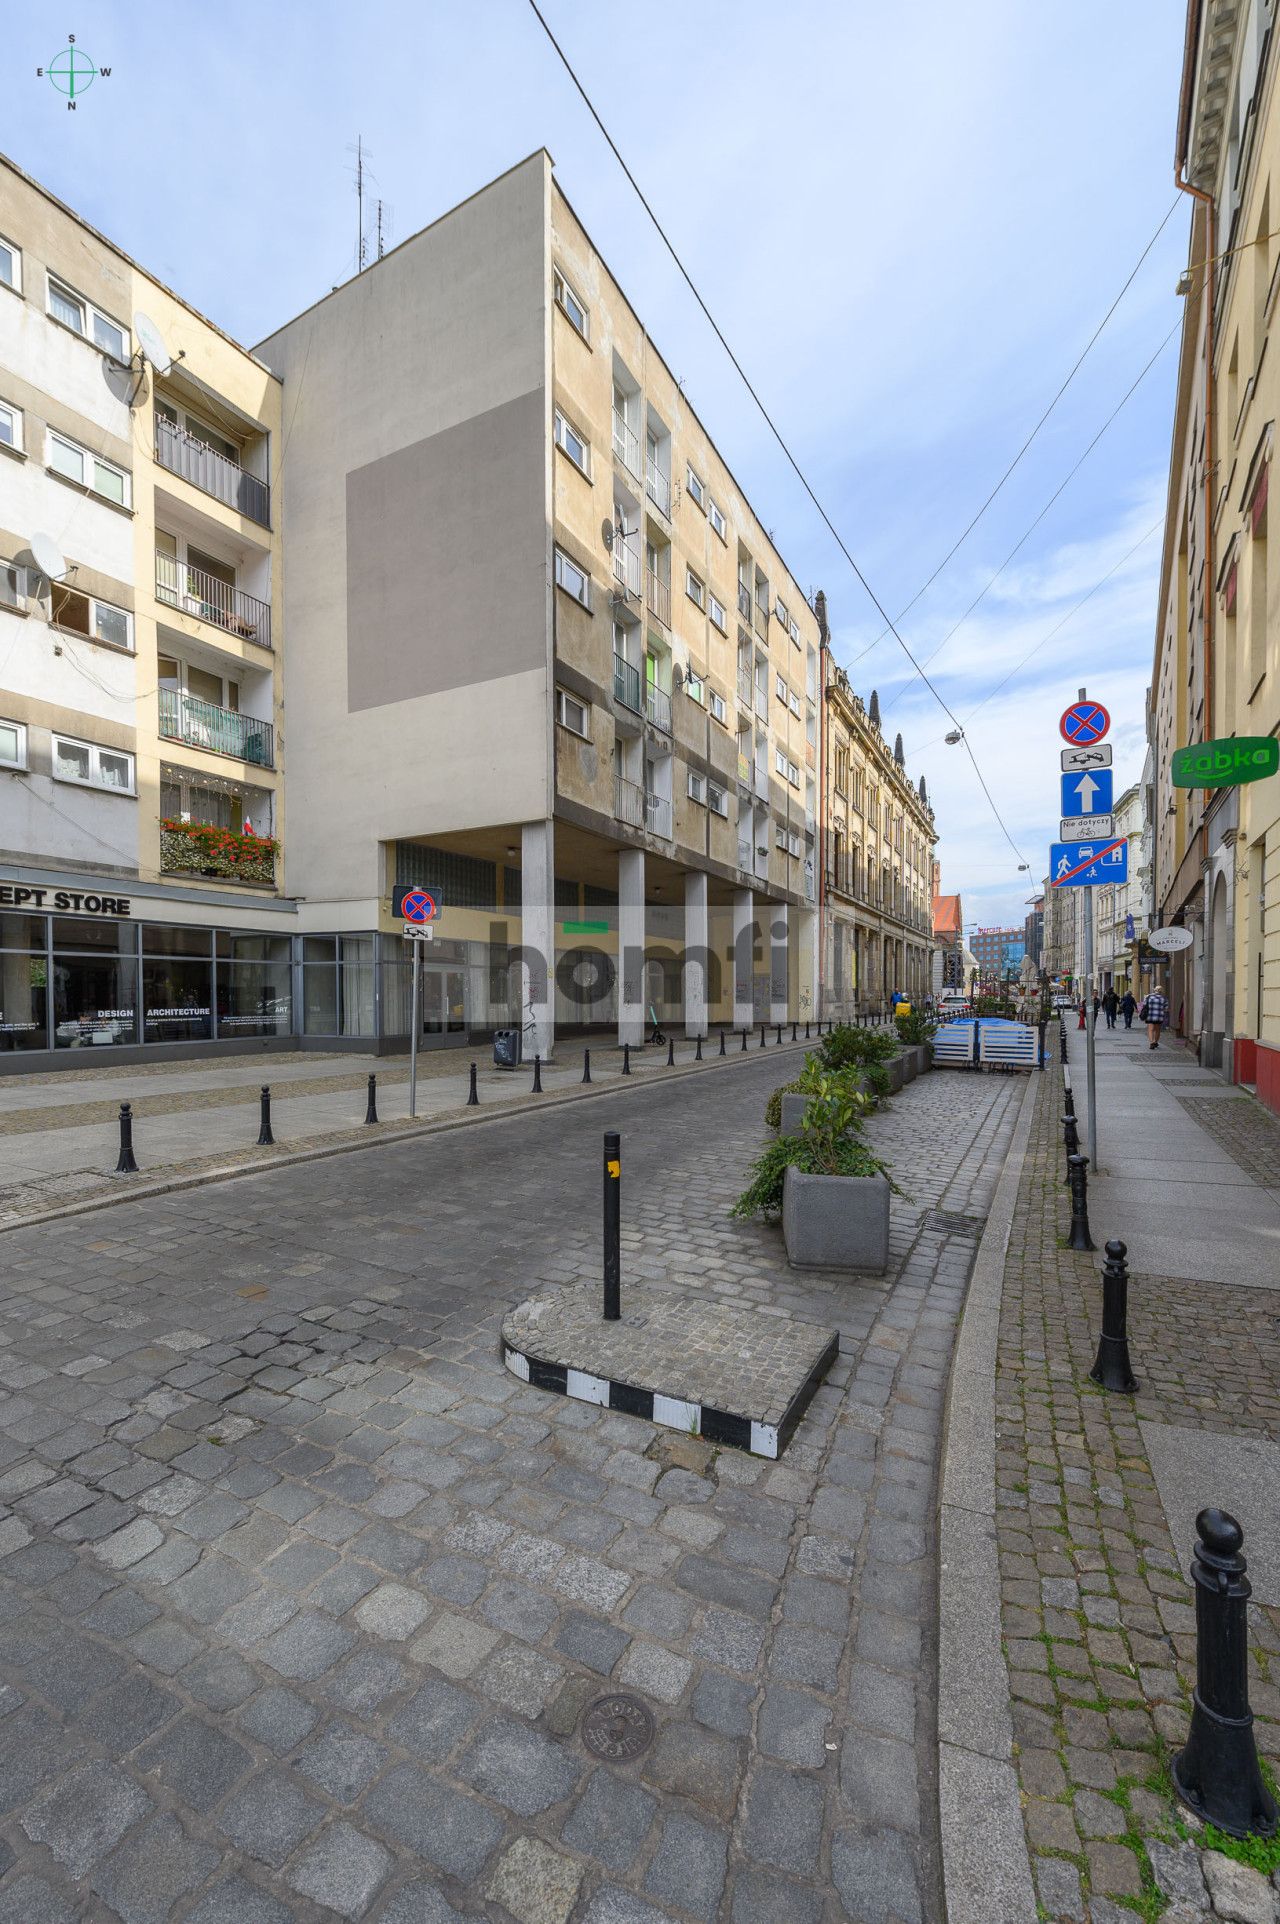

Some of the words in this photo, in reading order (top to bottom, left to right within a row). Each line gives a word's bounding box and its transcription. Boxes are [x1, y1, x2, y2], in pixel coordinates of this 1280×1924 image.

[1078, 818, 1109, 826] dotyczy
[54, 892, 130, 915] STORE
[97, 1009, 134, 1018] DESIGN
[147, 1008, 210, 1017] ARCHITECTURE
